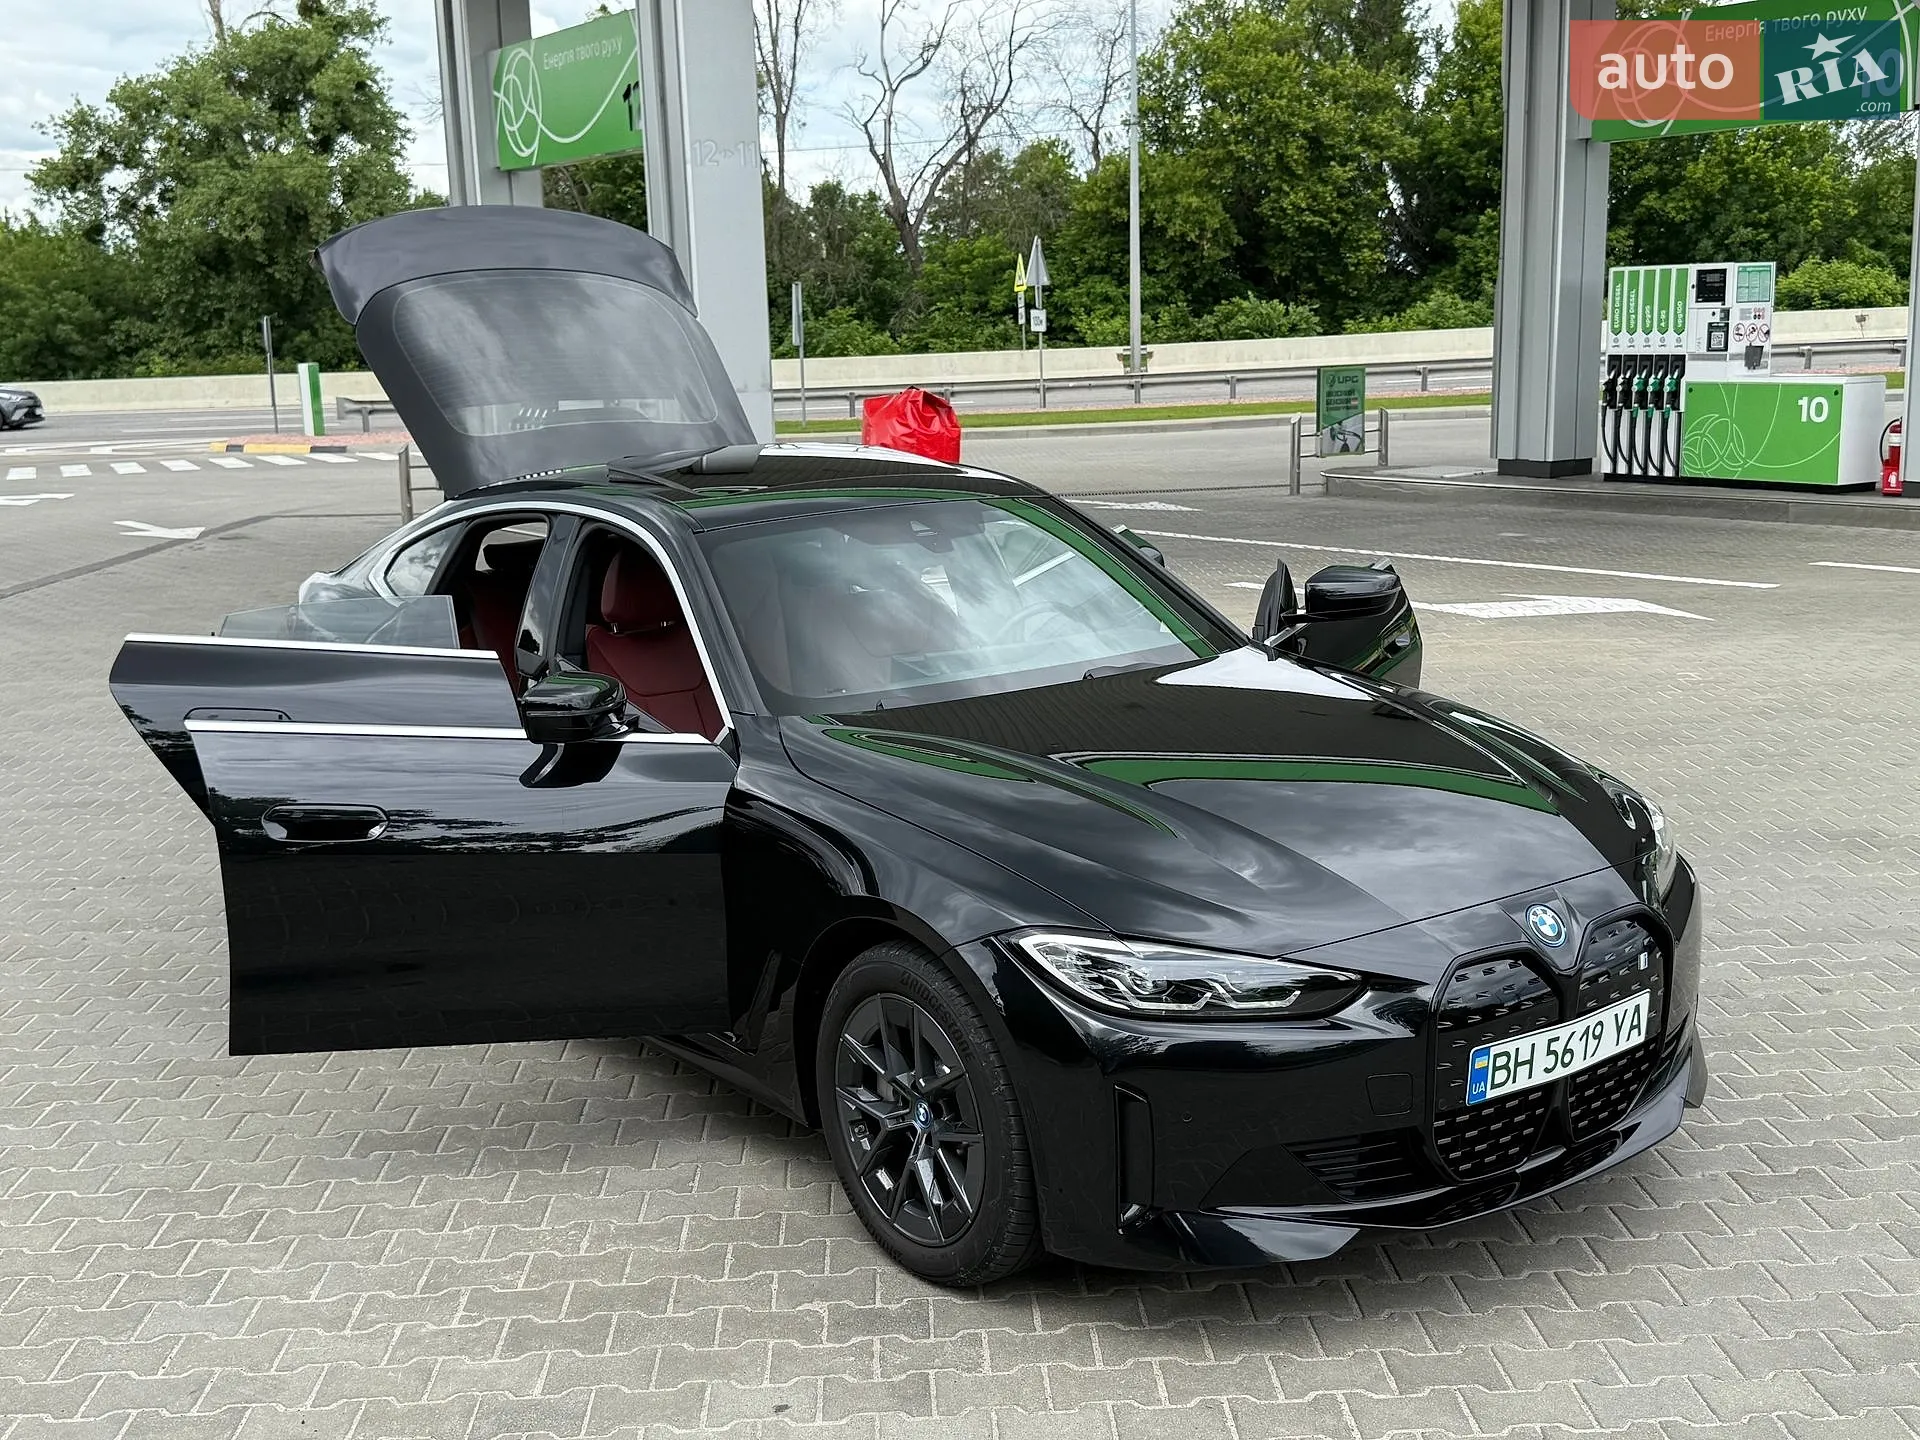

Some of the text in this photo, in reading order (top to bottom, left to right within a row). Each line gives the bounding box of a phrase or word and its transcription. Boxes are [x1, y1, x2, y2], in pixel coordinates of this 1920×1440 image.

[1705, 6, 1868, 42] Енергія твого руху
[691, 139, 758, 168] 12 11
[1798, 396, 1829, 423] 10
[1490, 1003, 1642, 1091] BH 5619 YA
[1472, 1082, 1486, 1095] UA
